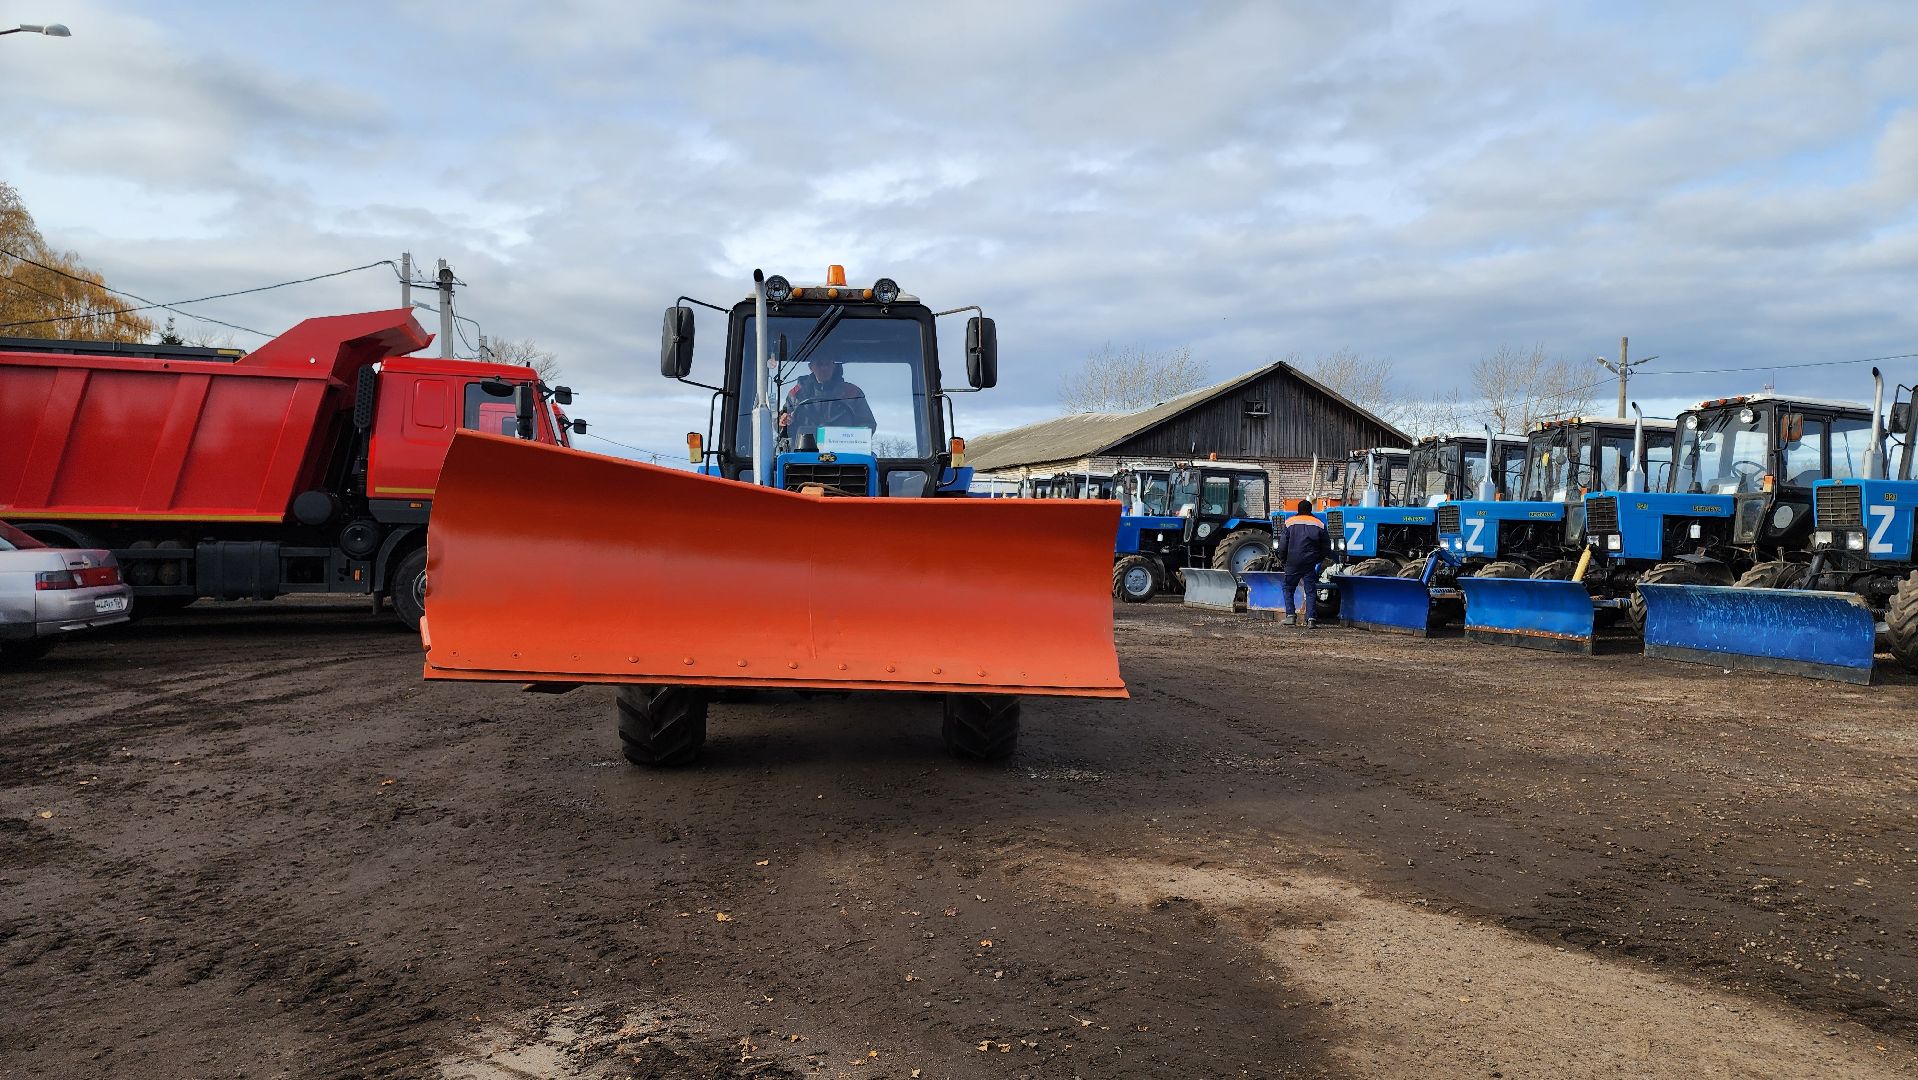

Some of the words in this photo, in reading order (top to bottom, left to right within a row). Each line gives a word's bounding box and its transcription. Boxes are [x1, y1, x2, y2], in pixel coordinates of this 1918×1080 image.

[1346, 523, 1364, 550] Z
[1466, 519, 1484, 552] Z
[1869, 505, 1895, 553] Z
